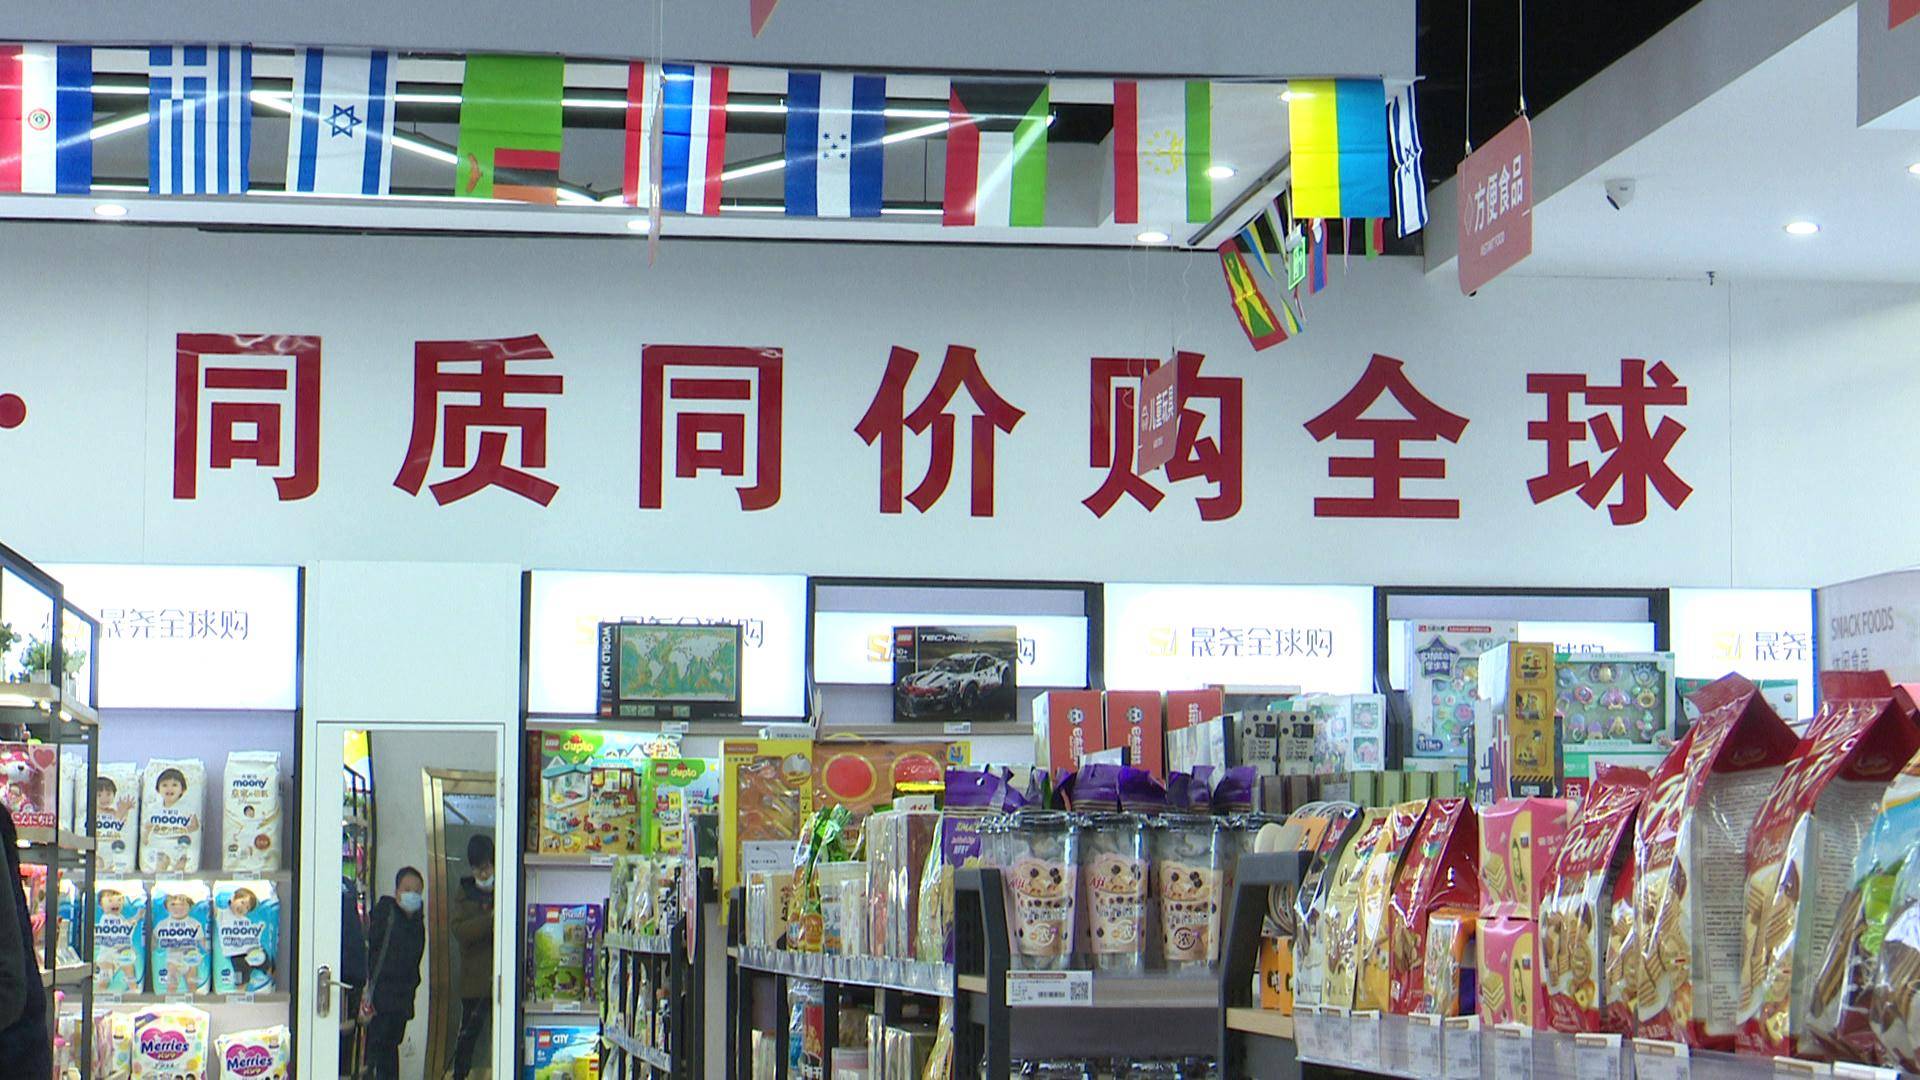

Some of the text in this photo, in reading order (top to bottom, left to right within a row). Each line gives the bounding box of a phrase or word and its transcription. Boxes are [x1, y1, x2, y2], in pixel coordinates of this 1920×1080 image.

[1474, 154, 1523, 233] 方便食品
[174, 332, 1694, 525] 同质同价购全球
[100, 608, 248, 641] 晟尧全球购
[1862, 606, 1895, 635] FOODS
[601, 625, 612, 663] WORLD
[920, 632, 968, 643] TECHNIC
[1191, 626, 1334, 658] 晟尧全球购
[232, 776, 269, 788] moony
[150, 814, 192, 827] moony
[157, 924, 200, 938] moony
[221, 923, 264, 937] moony
[141, 1040, 190, 1054] Merries
[552, 1034, 569, 1045] CITY
[226, 1055, 273, 1072] Merries
